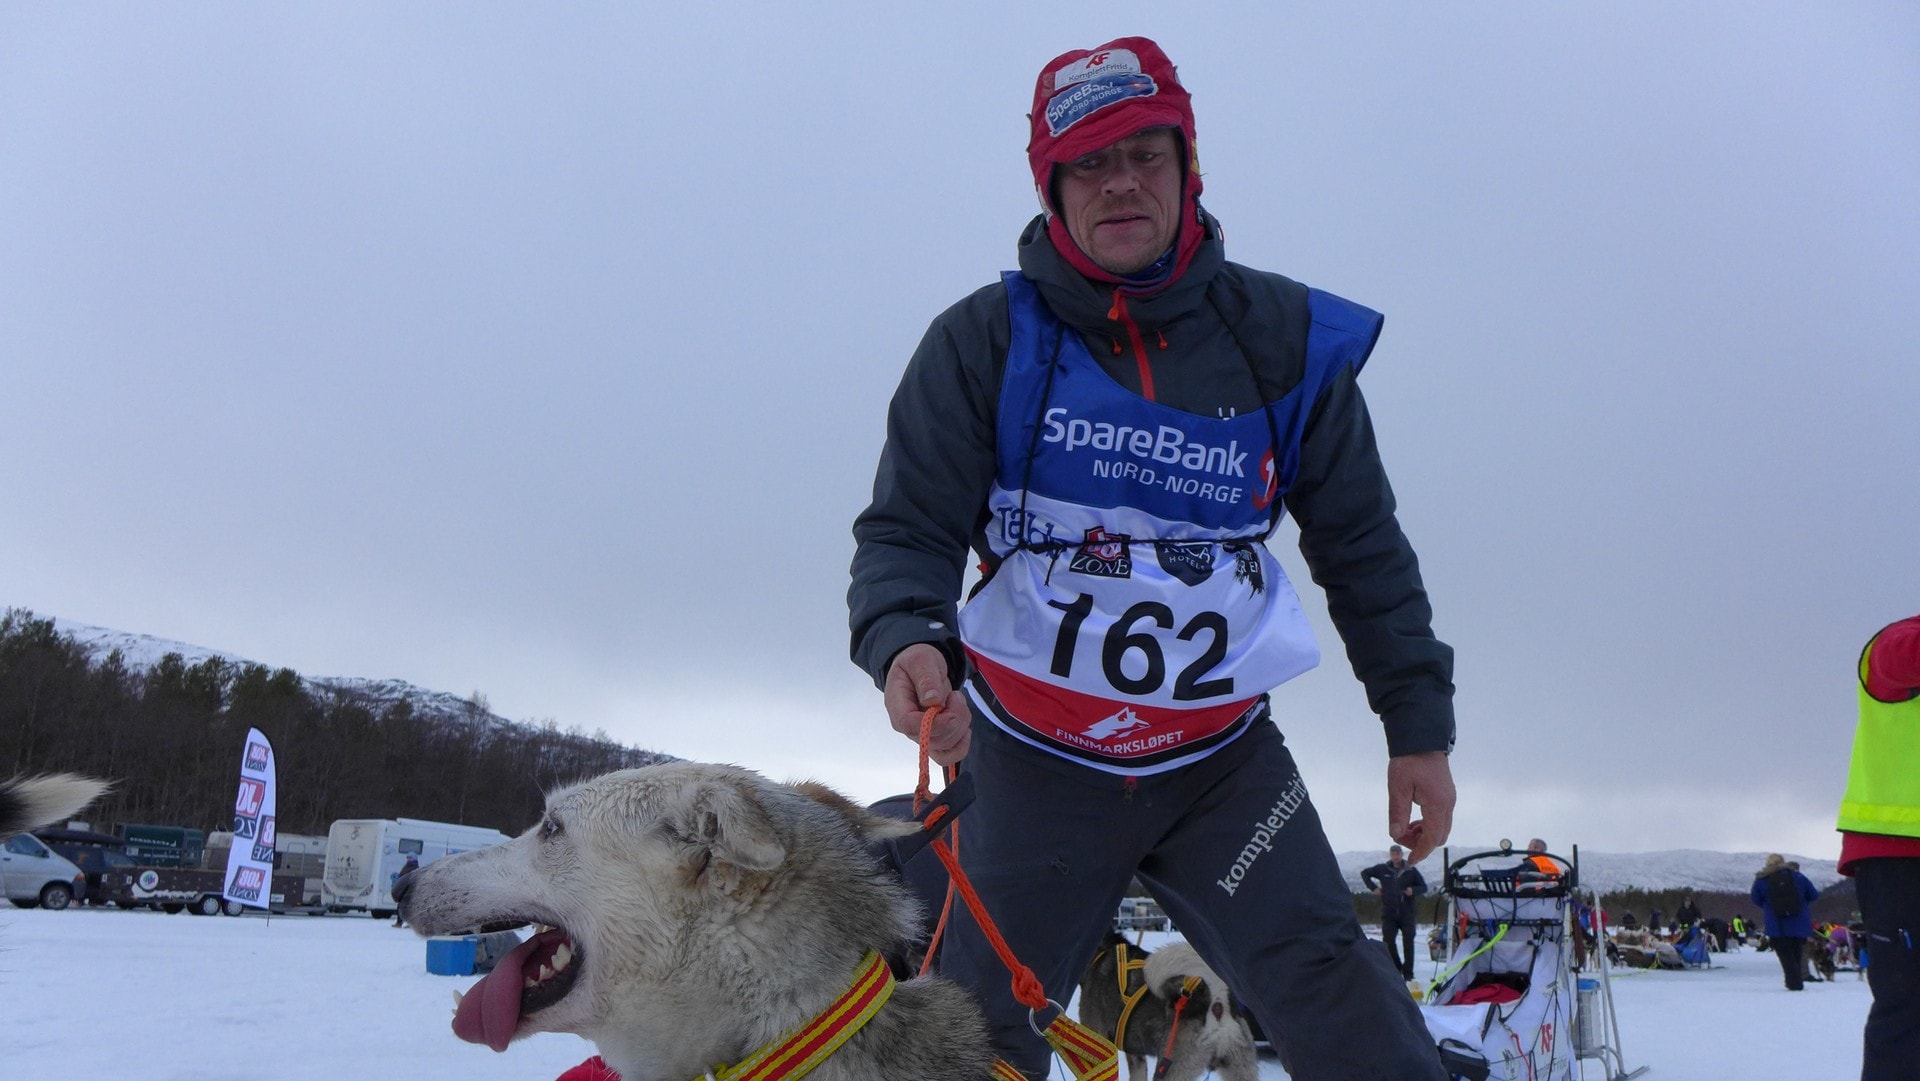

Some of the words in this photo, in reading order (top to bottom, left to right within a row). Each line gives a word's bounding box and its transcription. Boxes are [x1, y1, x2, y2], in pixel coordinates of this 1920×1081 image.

[1043, 407, 1249, 478] SpareBank
[1093, 459, 1244, 505] NORD-NORGE
[1071, 555, 1130, 575] ZONE
[1047, 593, 1234, 701] 162
[1056, 728, 1185, 754] FINNMARKSLØPET
